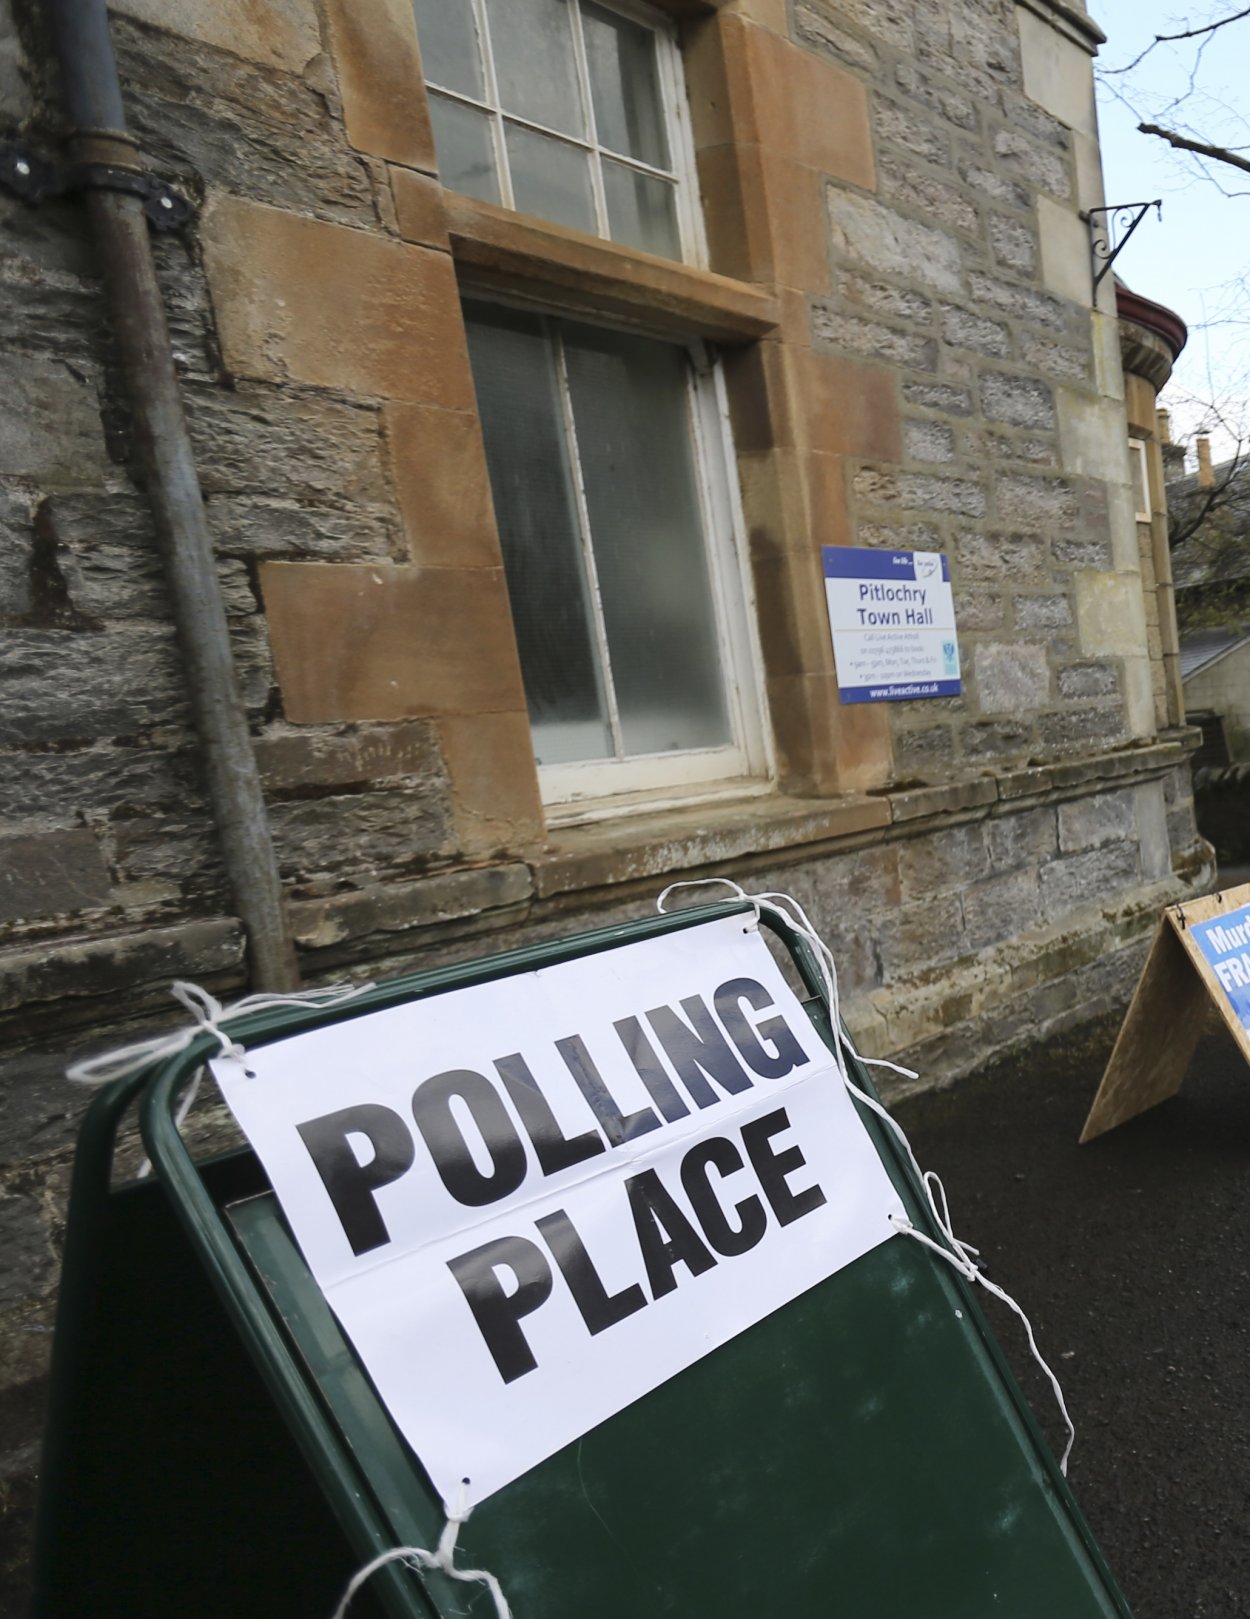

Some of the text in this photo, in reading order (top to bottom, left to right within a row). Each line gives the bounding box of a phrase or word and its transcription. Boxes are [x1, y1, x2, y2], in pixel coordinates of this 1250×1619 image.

[859, 584, 926, 606] Pitlochry
[857, 608, 933, 625] Town Hall
[869, 682, 939, 698] www.liveactive.co.uk
[296, 977, 810, 1257] POLLING
[446, 1106, 827, 1385] PLACE
